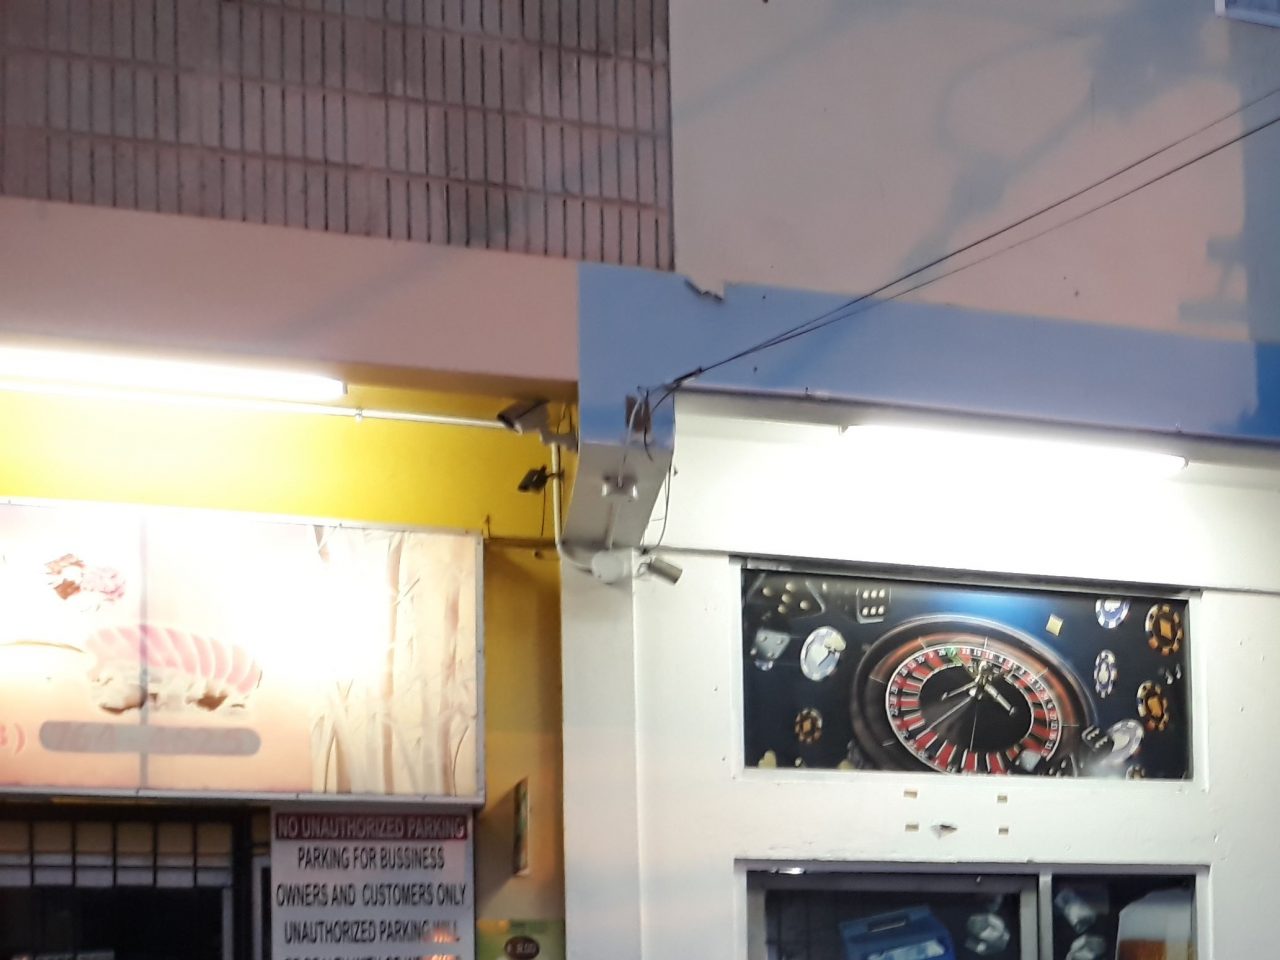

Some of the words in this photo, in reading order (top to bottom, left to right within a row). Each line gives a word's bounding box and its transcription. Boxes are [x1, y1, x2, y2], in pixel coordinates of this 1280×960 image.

[278, 815, 298, 838] NO
[302, 815, 404, 838] UNAUTHORIZED
[407, 815, 465, 838] PARKING
[298, 847, 350, 870] PARKING
[353, 847, 376, 870] FOR
[380, 846, 445, 870] BUSSINESS
[276, 883, 328, 907] OWNERS
[331, 883, 356, 906] AND
[361, 883, 434, 906] CUSTOMERS
[436, 883, 466, 906] ONLY
[284, 920, 376, 944] UNAUTHORIZED
[379, 920, 429, 944] PARKING
